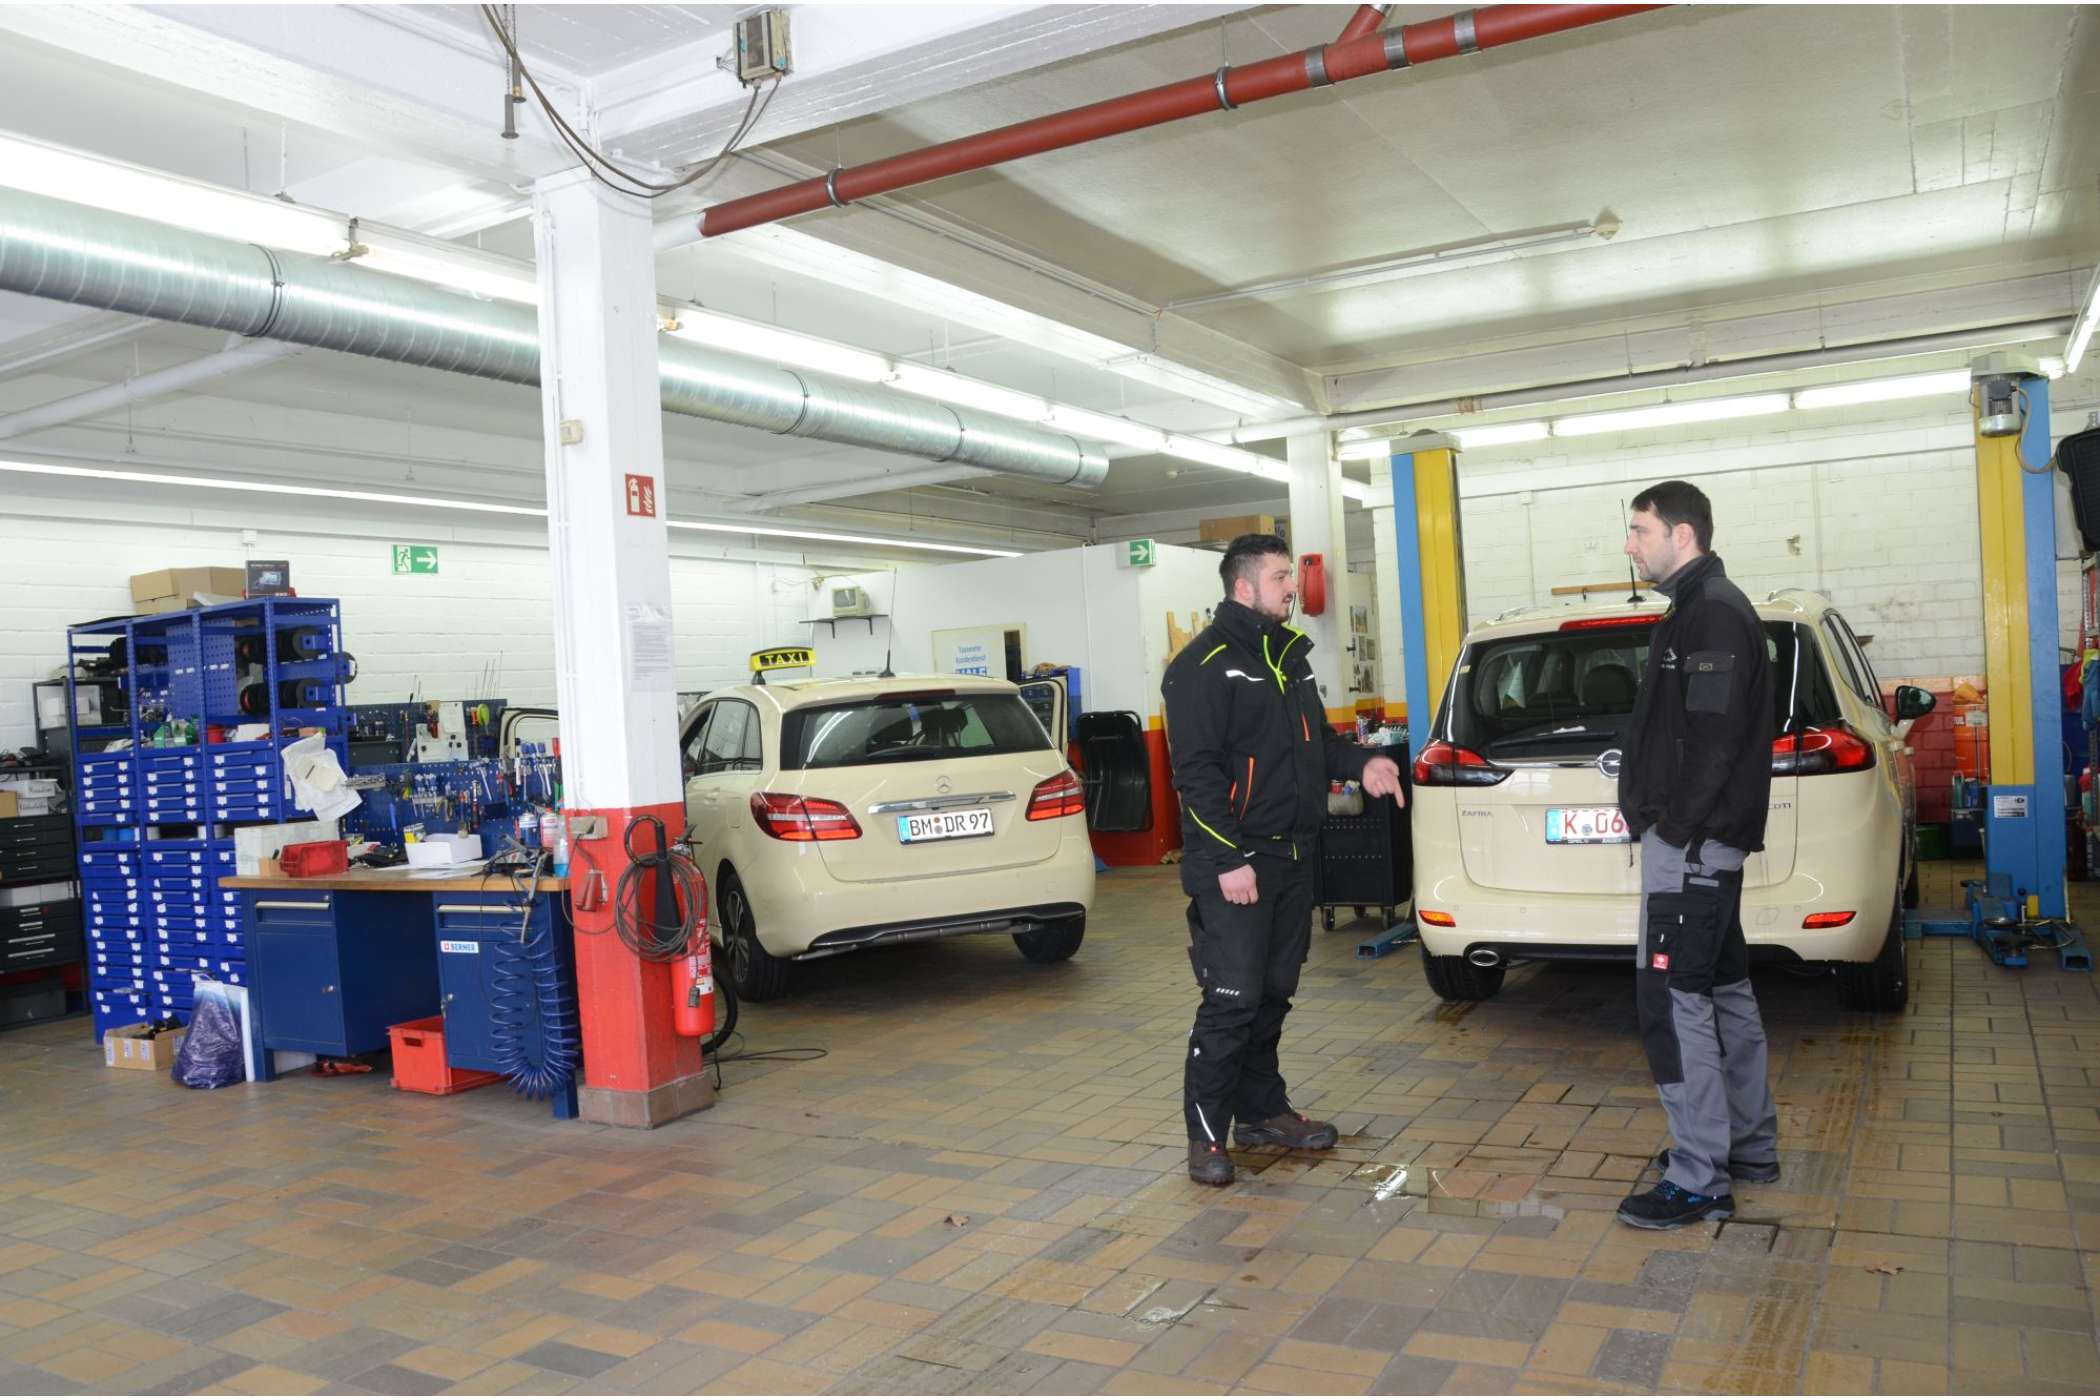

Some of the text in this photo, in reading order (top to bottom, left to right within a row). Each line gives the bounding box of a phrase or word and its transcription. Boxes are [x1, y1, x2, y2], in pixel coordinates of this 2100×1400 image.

[765, 652, 809, 665] TAXI
[909, 812, 988, 836] BM DR 97
[1564, 813, 1577, 835] K
